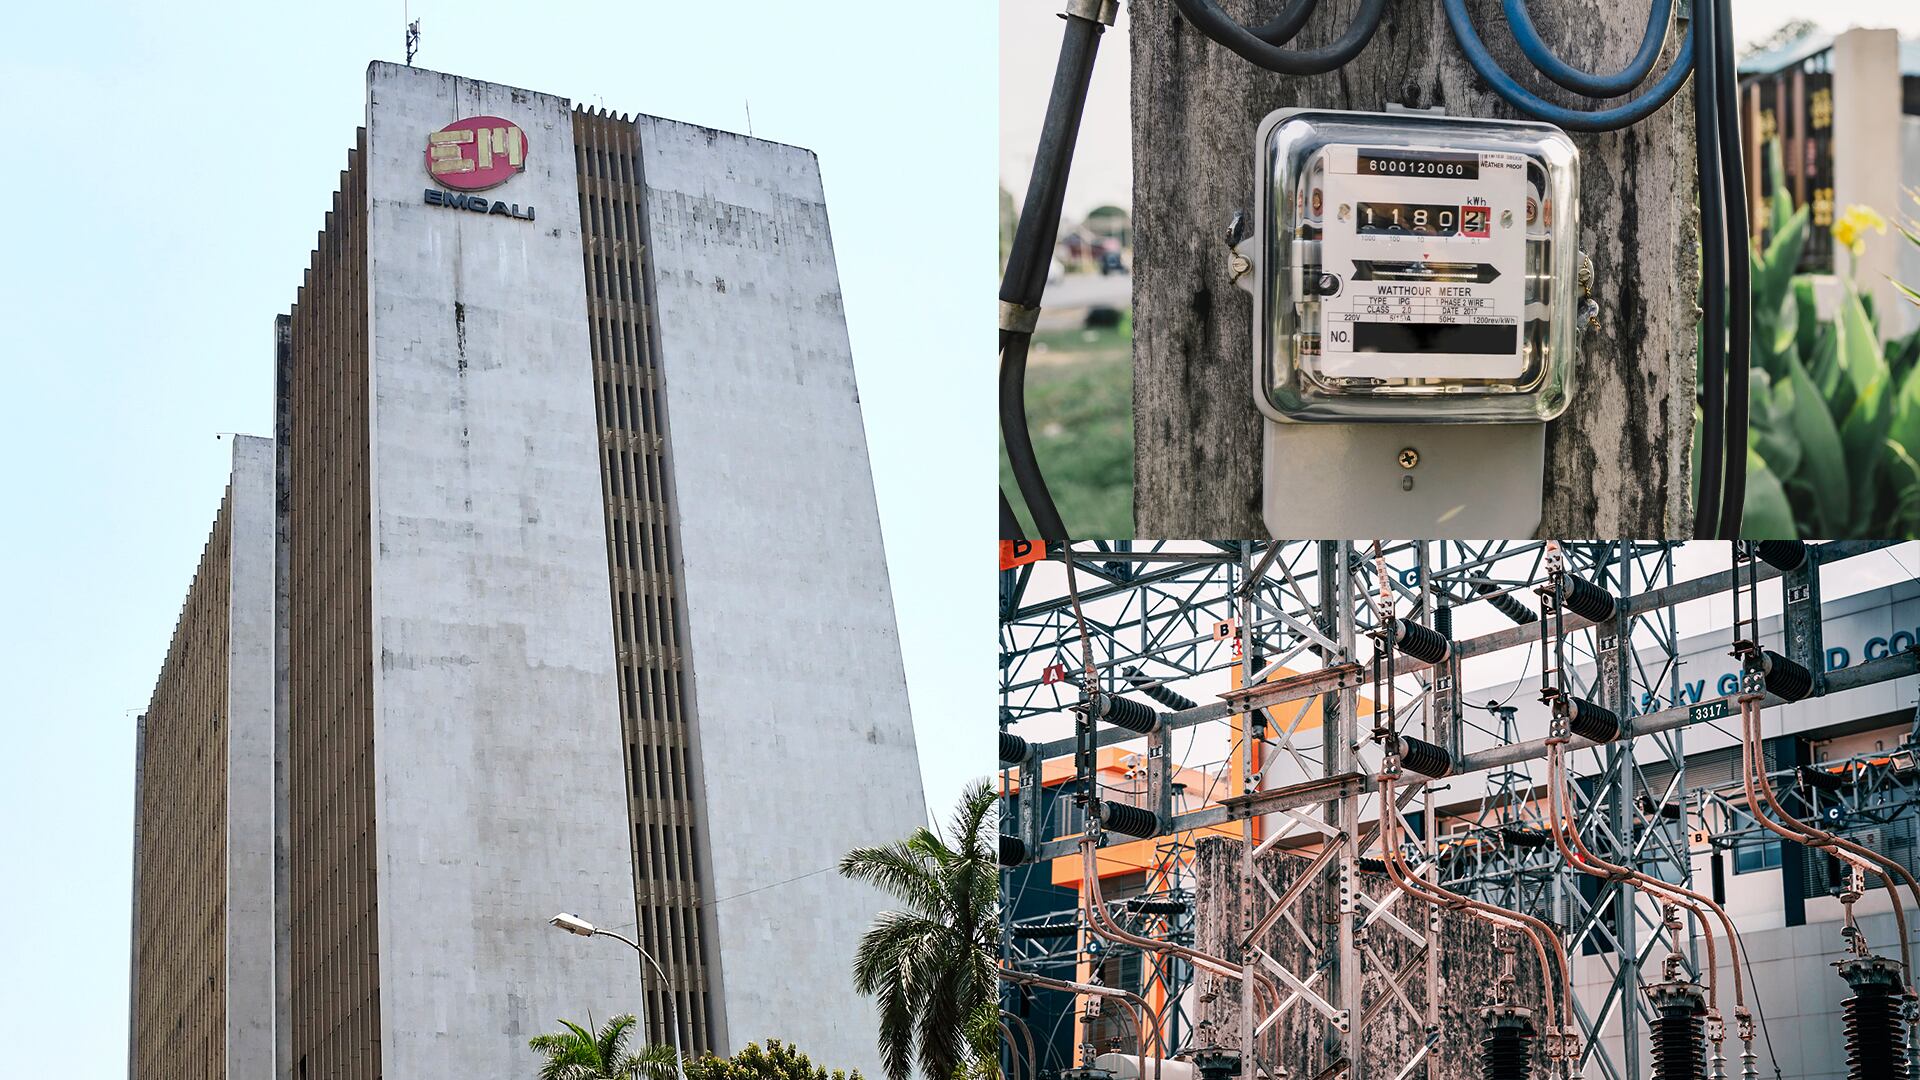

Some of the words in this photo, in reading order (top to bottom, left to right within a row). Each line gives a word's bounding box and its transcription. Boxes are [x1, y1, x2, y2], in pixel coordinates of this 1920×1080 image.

[1369, 159, 1464, 175] 6000120060
[1480, 160, 1504, 168] WEATHER
[424, 188, 536, 221] EMCALI
[1467, 196, 1487, 206] kWh
[1377, 285, 1432, 296] WATTHOUR
[1439, 287, 1471, 297] METER
[1369, 296, 1387, 305] TYPE
[1440, 298, 1461, 307] PHASE
[1462, 299, 1467, 307] 2
[1468, 299, 1484, 307] WIRE
[1367, 305, 1390, 314] CLASS
[1402, 306, 1412, 314] 2.0
[1442, 307, 1459, 315] DATE
[1463, 307, 1478, 315] 2017
[1344, 313, 1361, 321] 220V
[1330, 330, 1350, 343] NO.
[1406, 571, 1417, 586] C
[1220, 623, 1230, 637] B
[1864, 627, 1920, 661] CO
[1049, 669, 1059, 682] A
[1695, 704, 1722, 720] 3317
[1829, 808, 1839, 819] C
[1695, 834, 1703, 843] B
[1090, 943, 1097, 952] C
